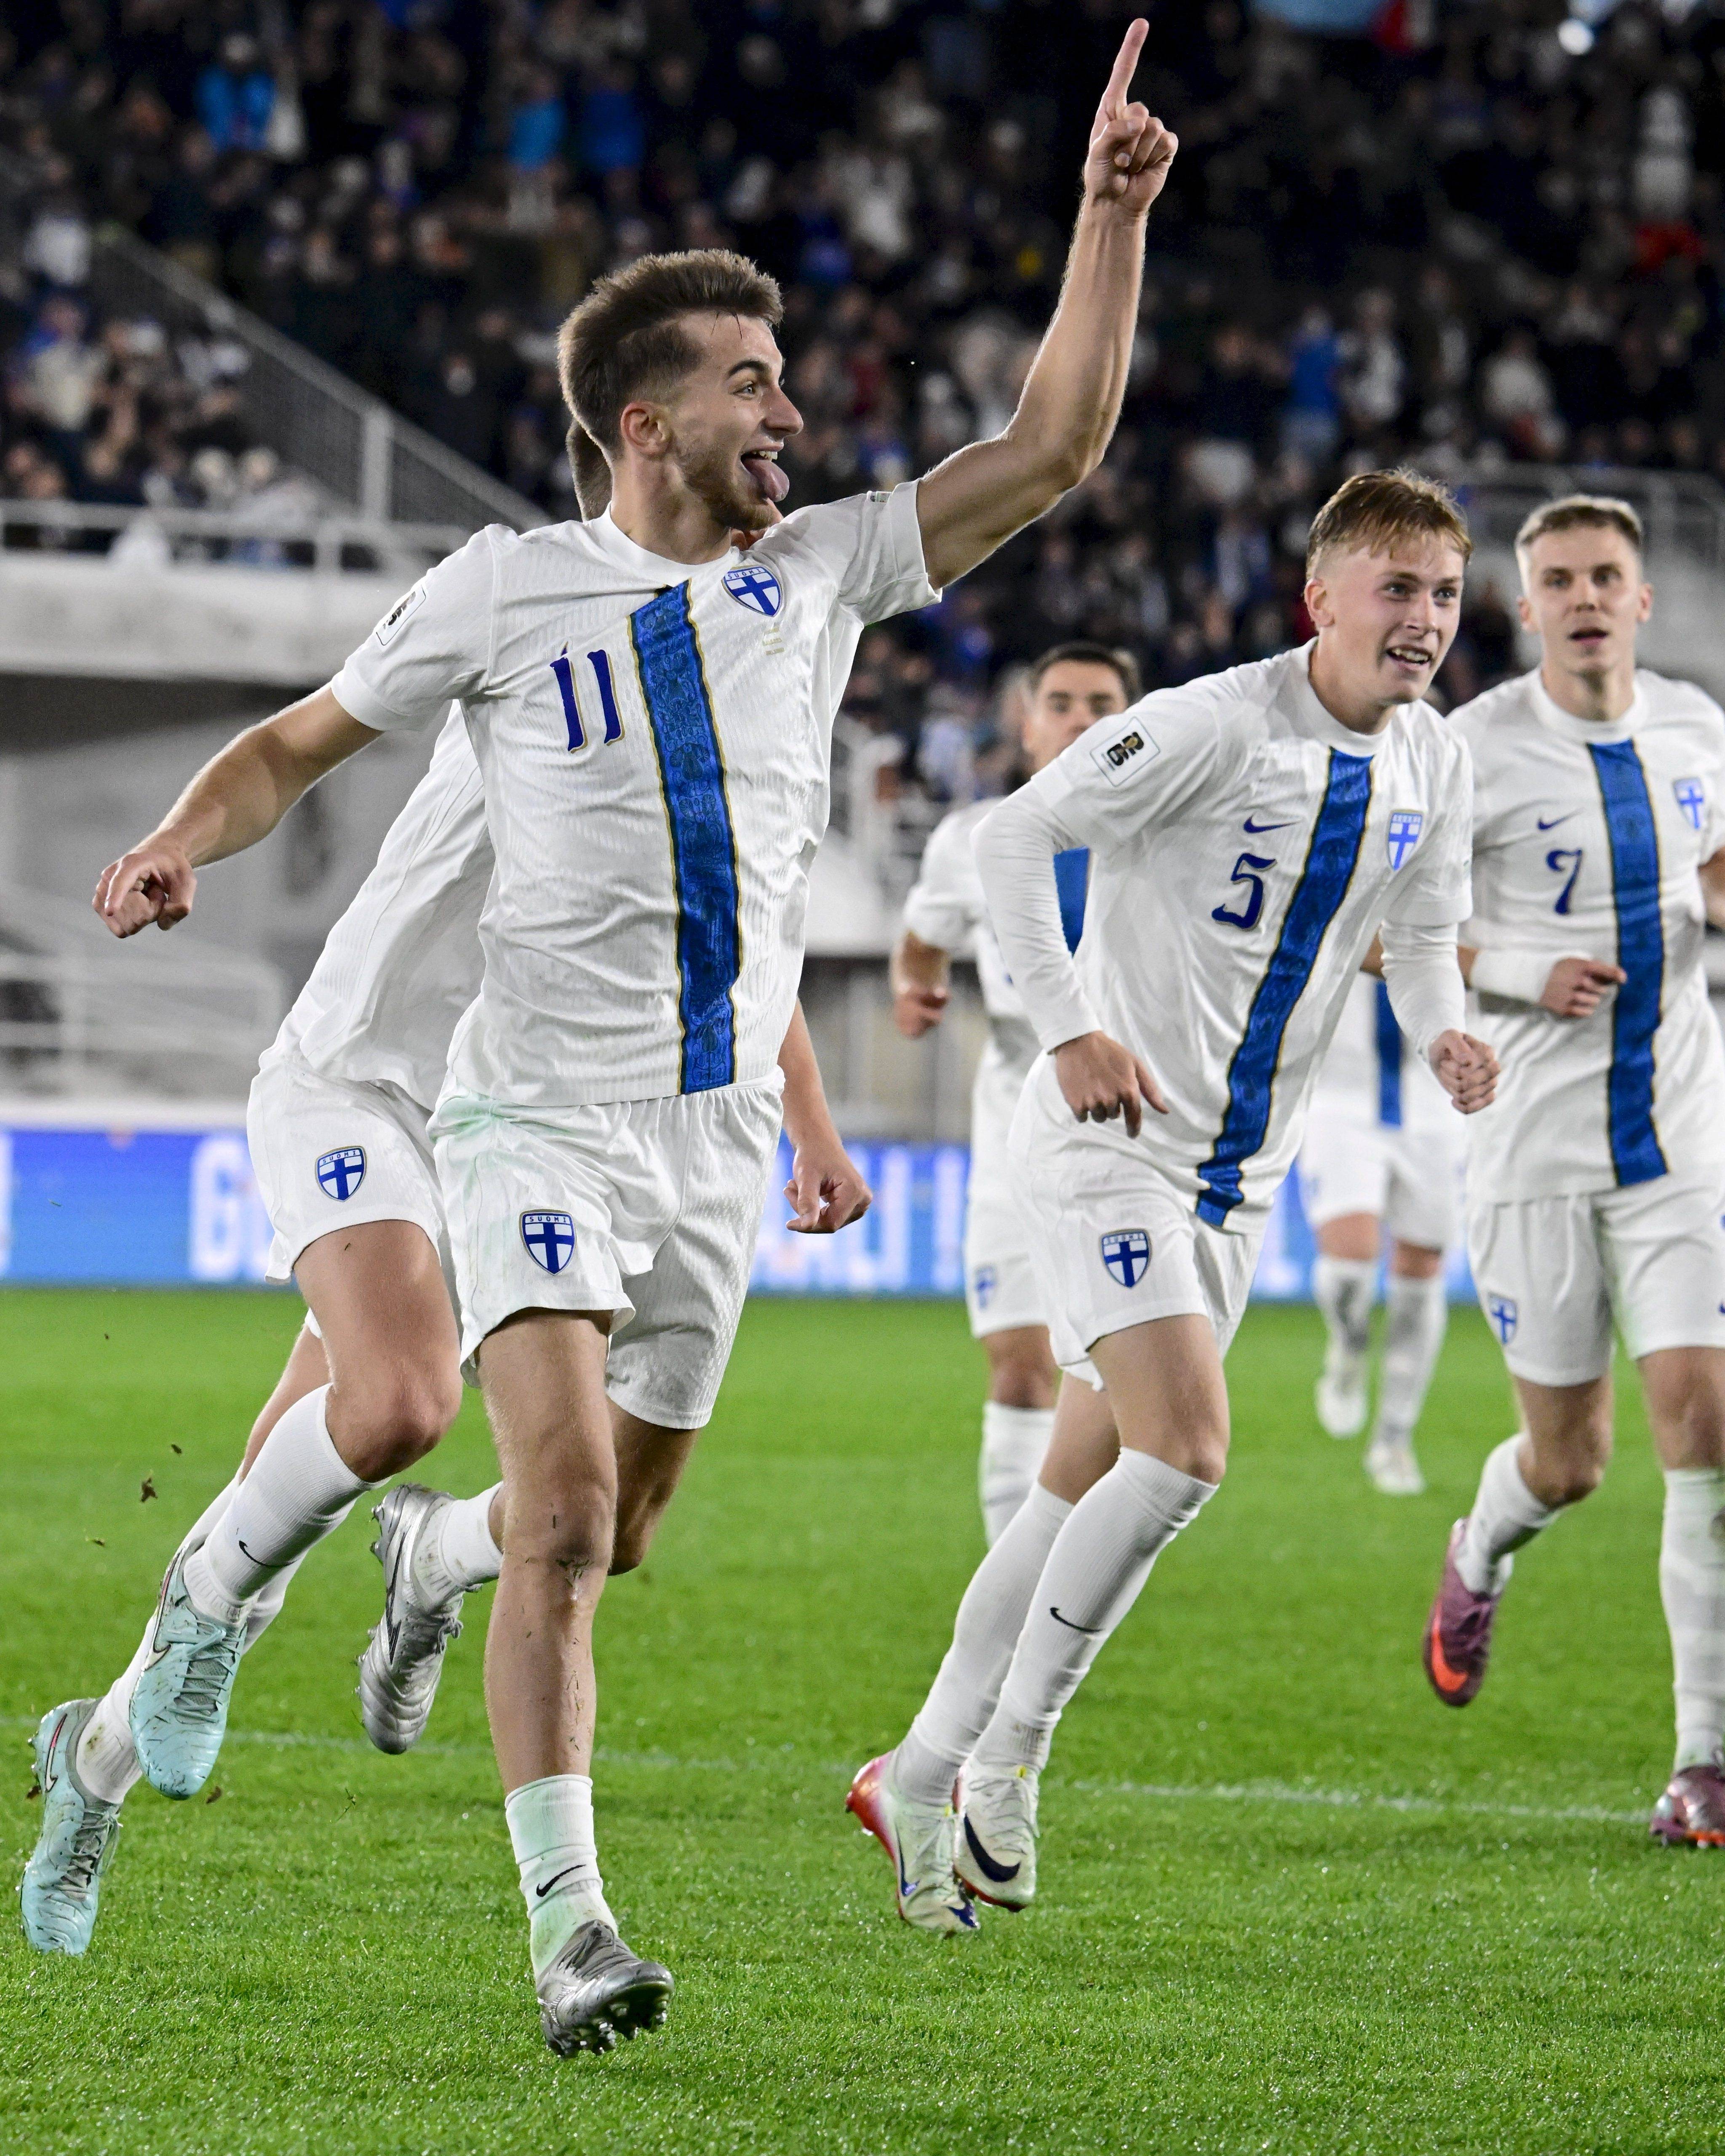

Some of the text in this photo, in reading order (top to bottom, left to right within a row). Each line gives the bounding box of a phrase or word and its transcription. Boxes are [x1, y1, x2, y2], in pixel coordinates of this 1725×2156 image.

[728, 568, 761, 579] SUOMI
[549, 641, 625, 754] 11
[1211, 853, 1277, 931] 5
[1545, 849, 1583, 915] 7
[323, 1150, 356, 1164] SUOMI
